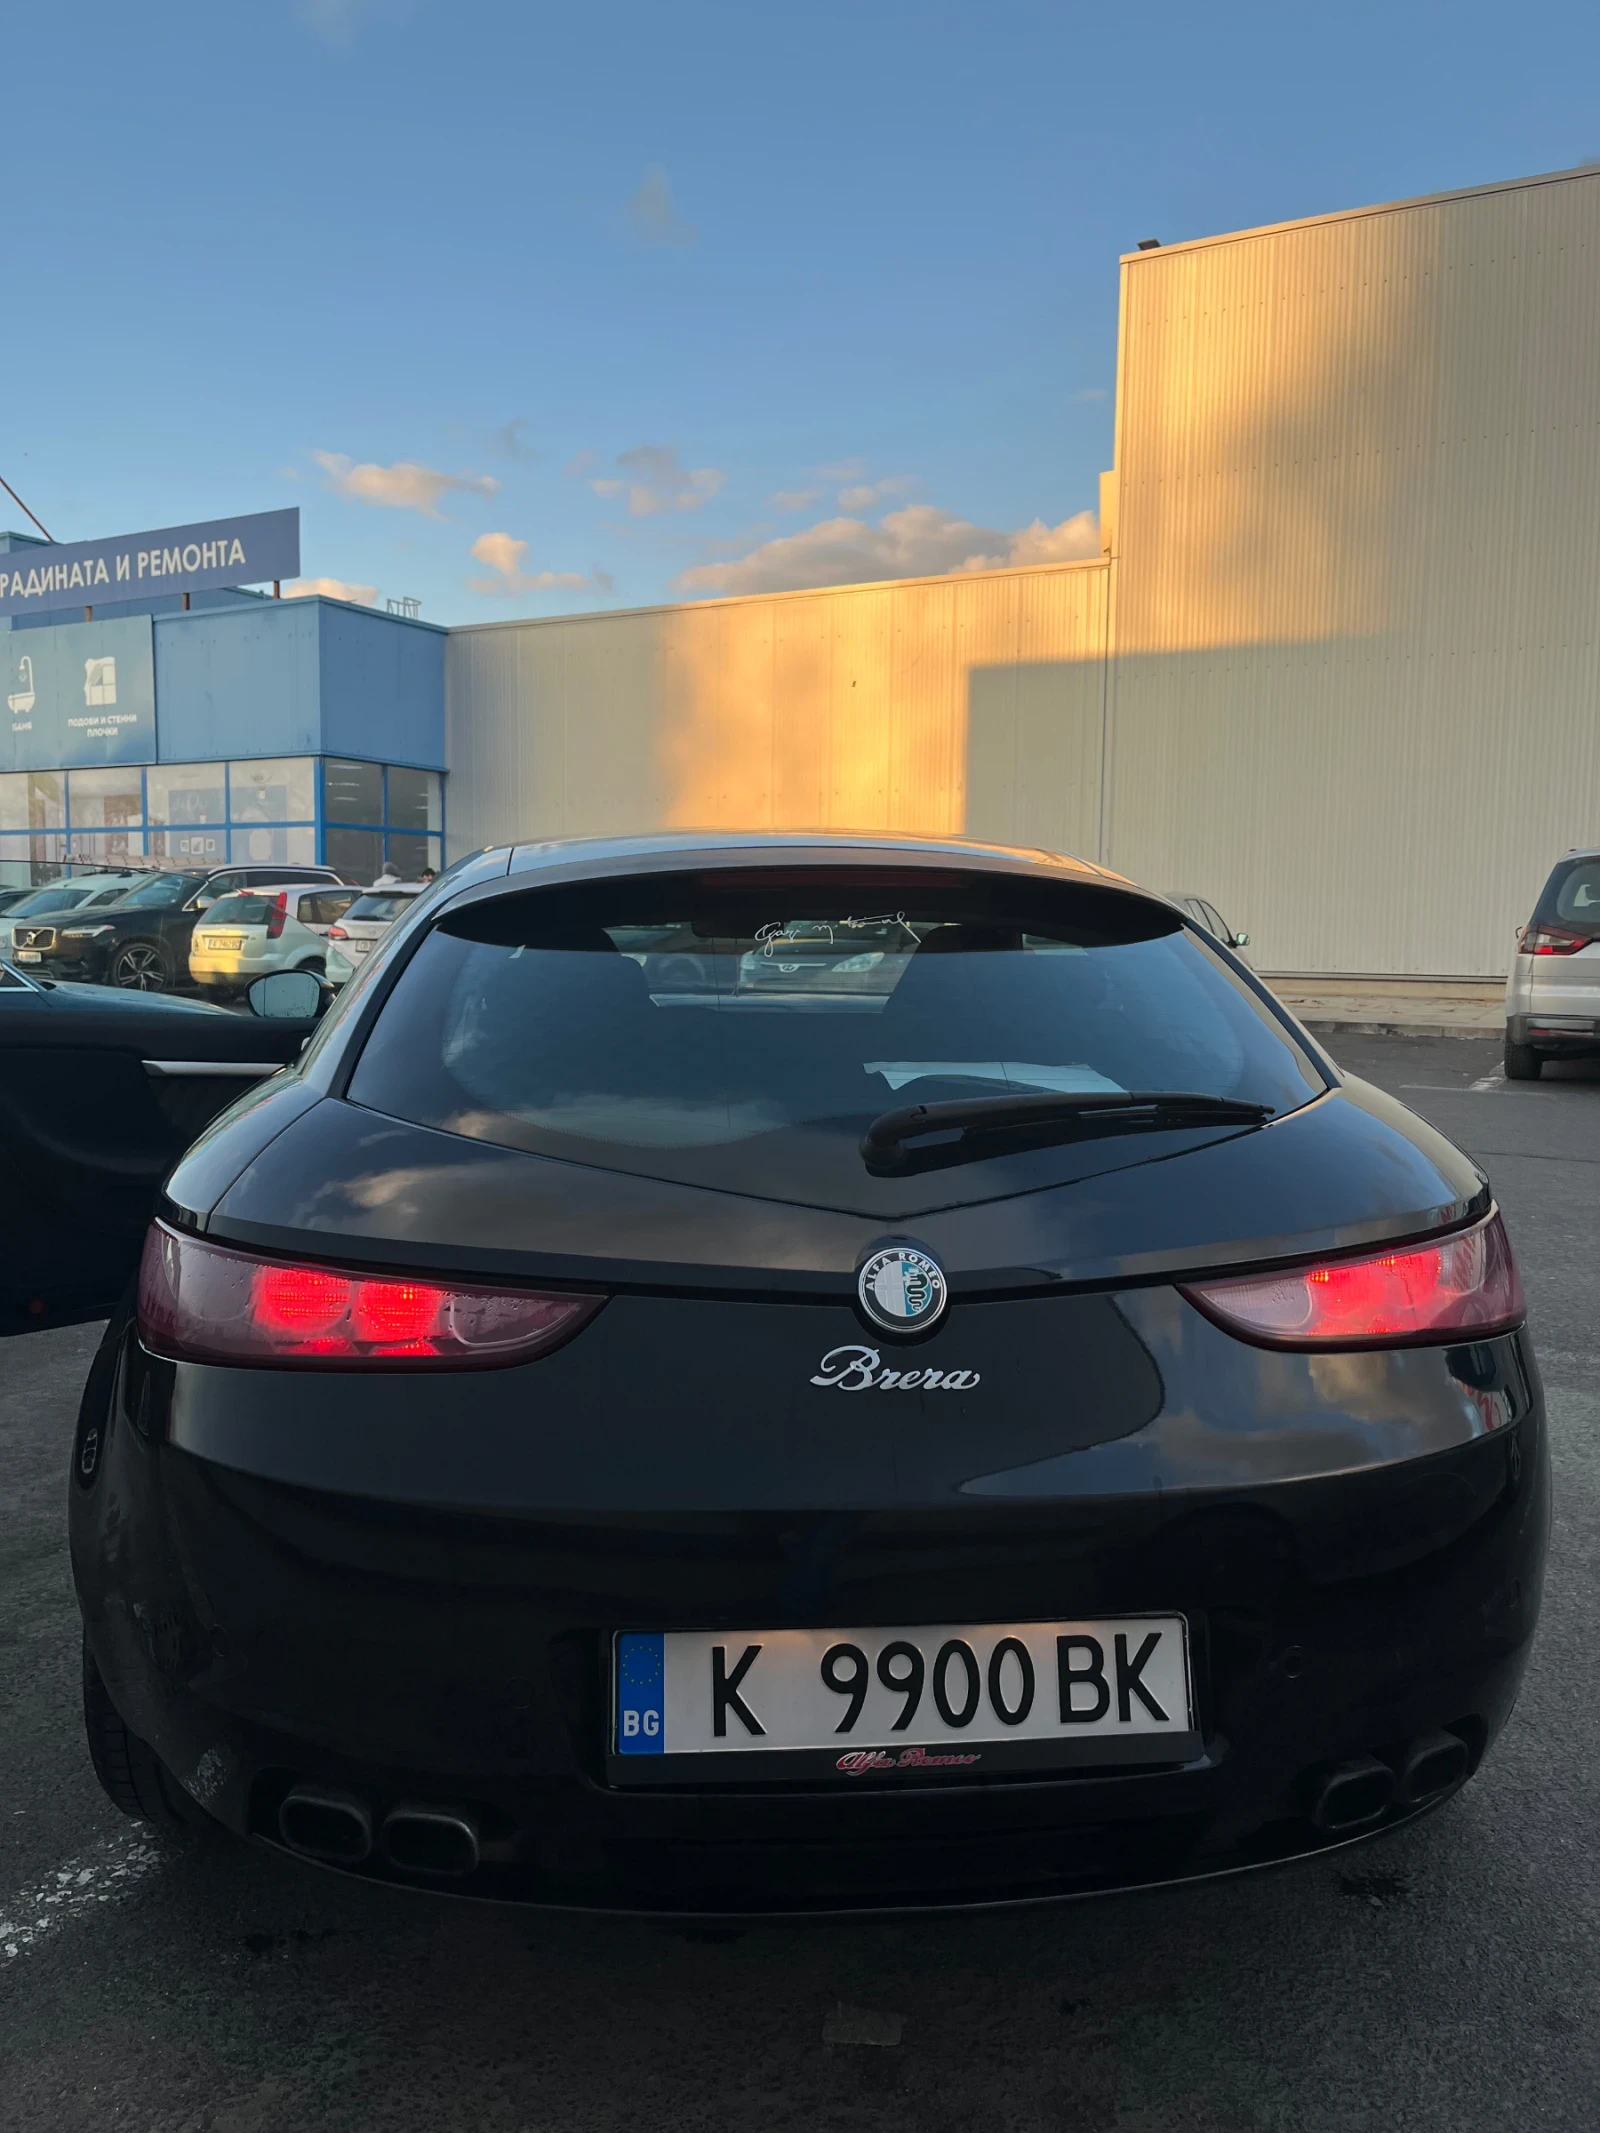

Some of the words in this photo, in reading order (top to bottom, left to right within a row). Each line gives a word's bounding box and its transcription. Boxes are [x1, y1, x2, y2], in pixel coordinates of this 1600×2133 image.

[0, 558, 109, 598] РАДИНАТА
[116, 553, 130, 581] И
[137, 538, 246, 579] РЕМОНТА
[68, 716, 99, 727] ПОДОВИ
[107, 714, 137, 725] СТЕННИ
[87, 727, 118, 737] ПЛОЧКИ
[865, 1256, 892, 1291] ALFA
[899, 1252, 941, 1289] ROMEO
[810, 1345, 980, 1391] Brera
[712, 1644, 767, 1737] K
[820, 1637, 1035, 1733] 9900
[1056, 1632, 1170, 1723] BK
[623, 1710, 659, 1737] BG
[836, 1750, 896, 1776] Alfa
[896, 1748, 981, 1767] Romeo
